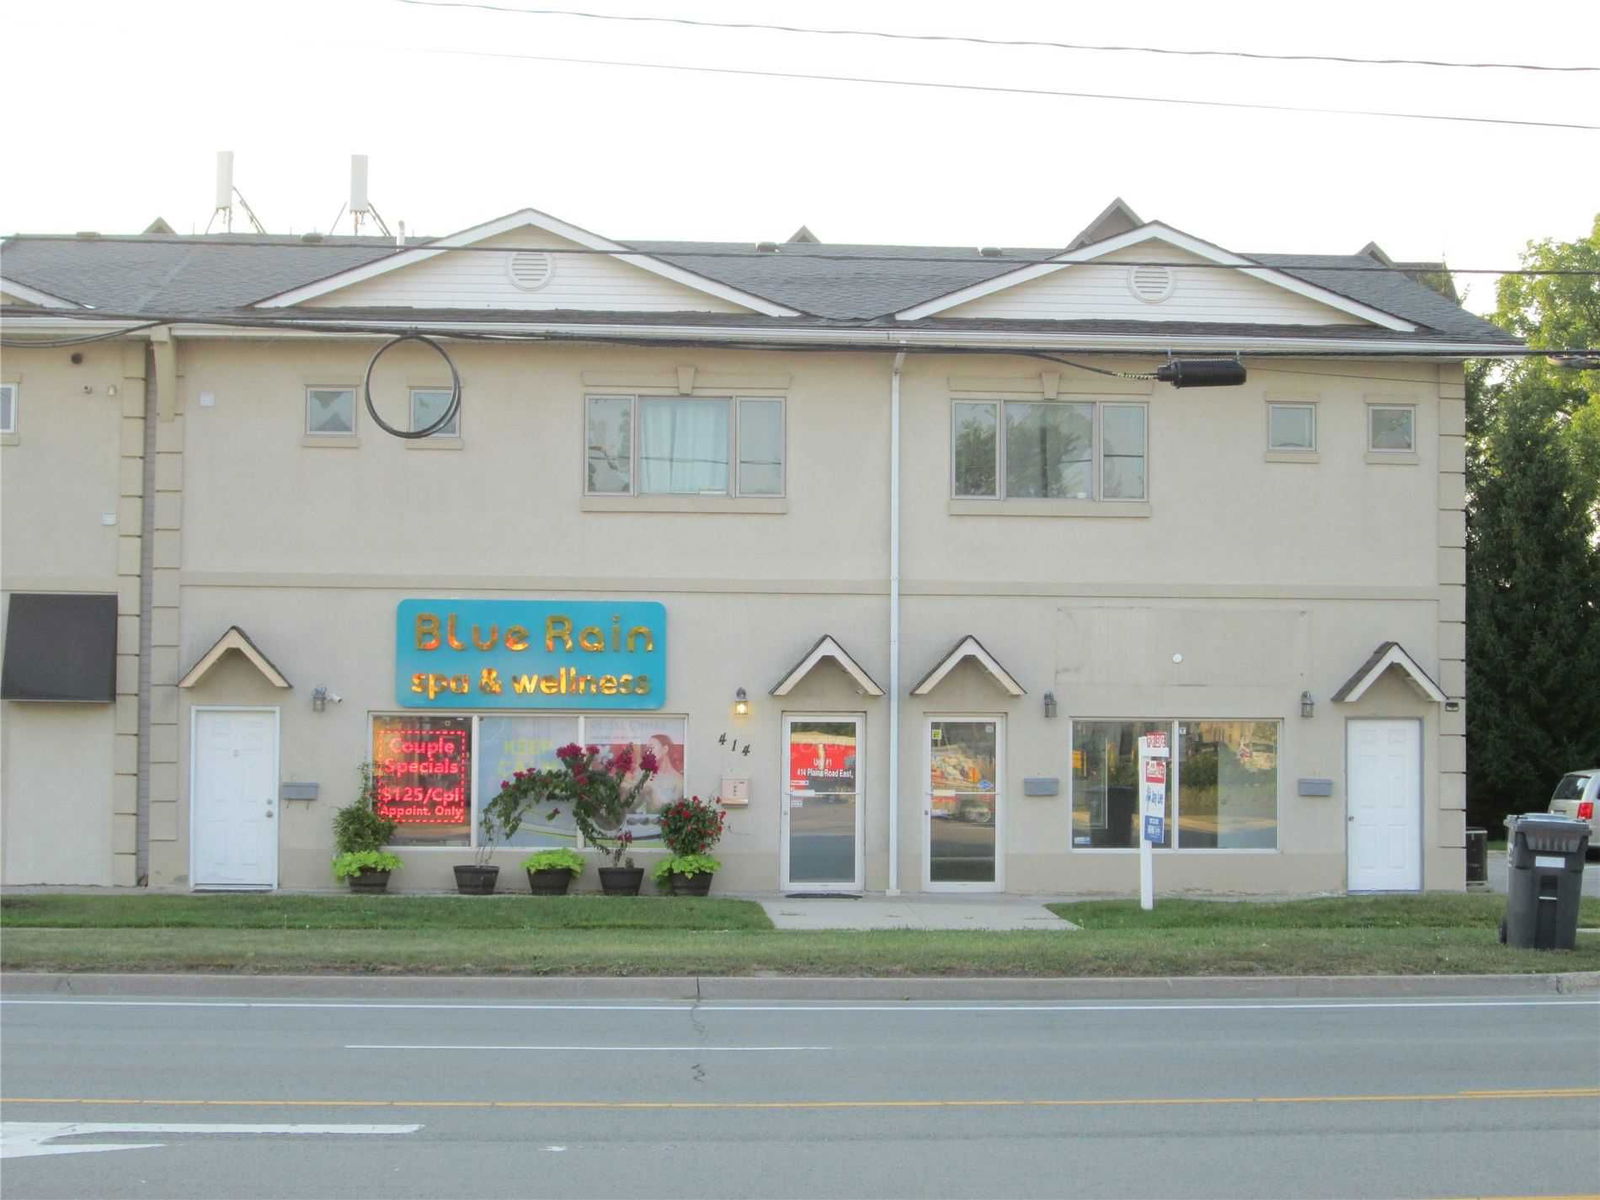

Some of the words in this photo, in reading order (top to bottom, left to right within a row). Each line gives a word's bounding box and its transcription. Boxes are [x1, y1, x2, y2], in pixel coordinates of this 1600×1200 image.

[414, 612, 530, 653] Blue
[545, 614, 655, 654] Rain
[411, 671, 470, 700] spa
[479, 667, 503, 696] &
[512, 667, 651, 696] wellness
[389, 737, 455, 758] Couple
[718, 732, 750, 756] 414
[384, 758, 459, 777] Specials
[824, 768, 839, 778] Road
[382, 786, 460, 805] $125/Cpl
[380, 805, 431, 818] Appoint.
[434, 805, 463, 819] Only
